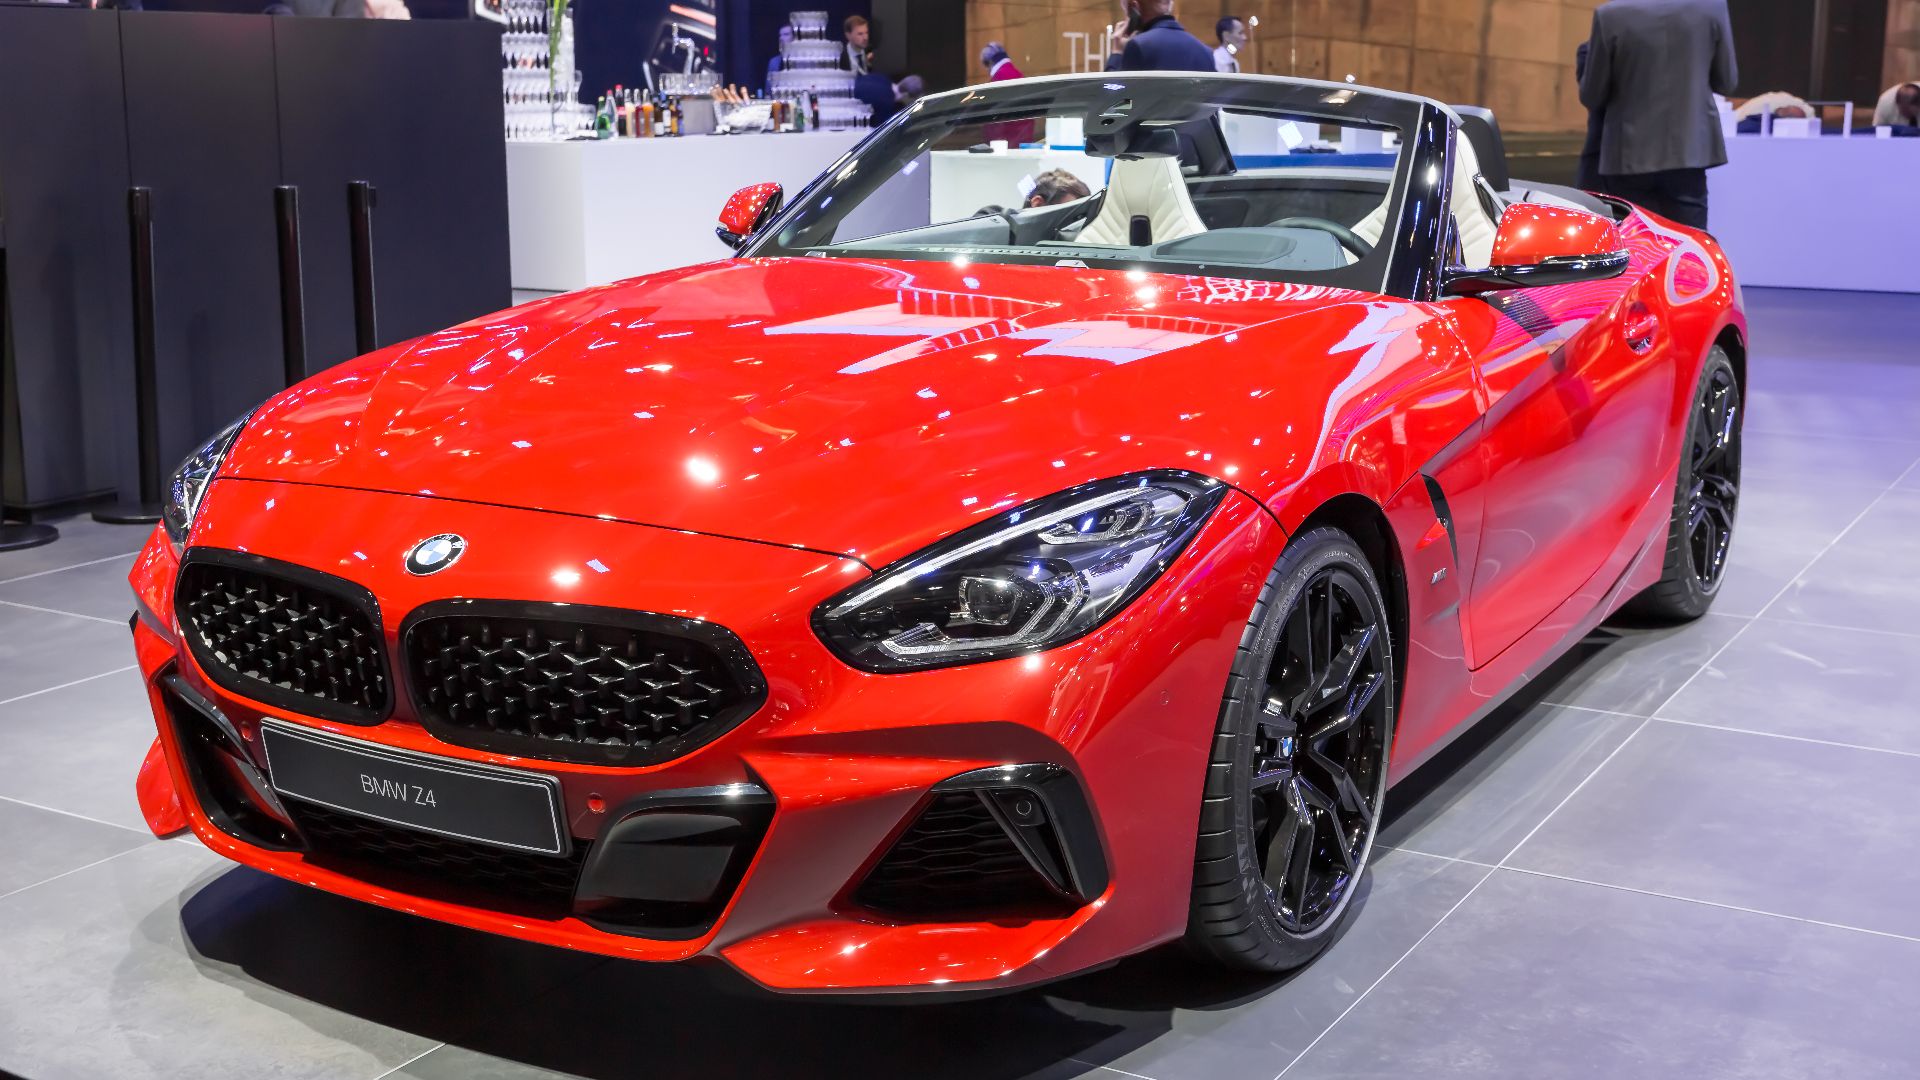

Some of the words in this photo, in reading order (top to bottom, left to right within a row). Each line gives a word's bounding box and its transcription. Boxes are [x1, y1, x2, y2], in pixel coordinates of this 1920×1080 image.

[1062, 31, 1112, 72] TH
[360, 773, 407, 802] BMW
[411, 785, 437, 808] Z4
